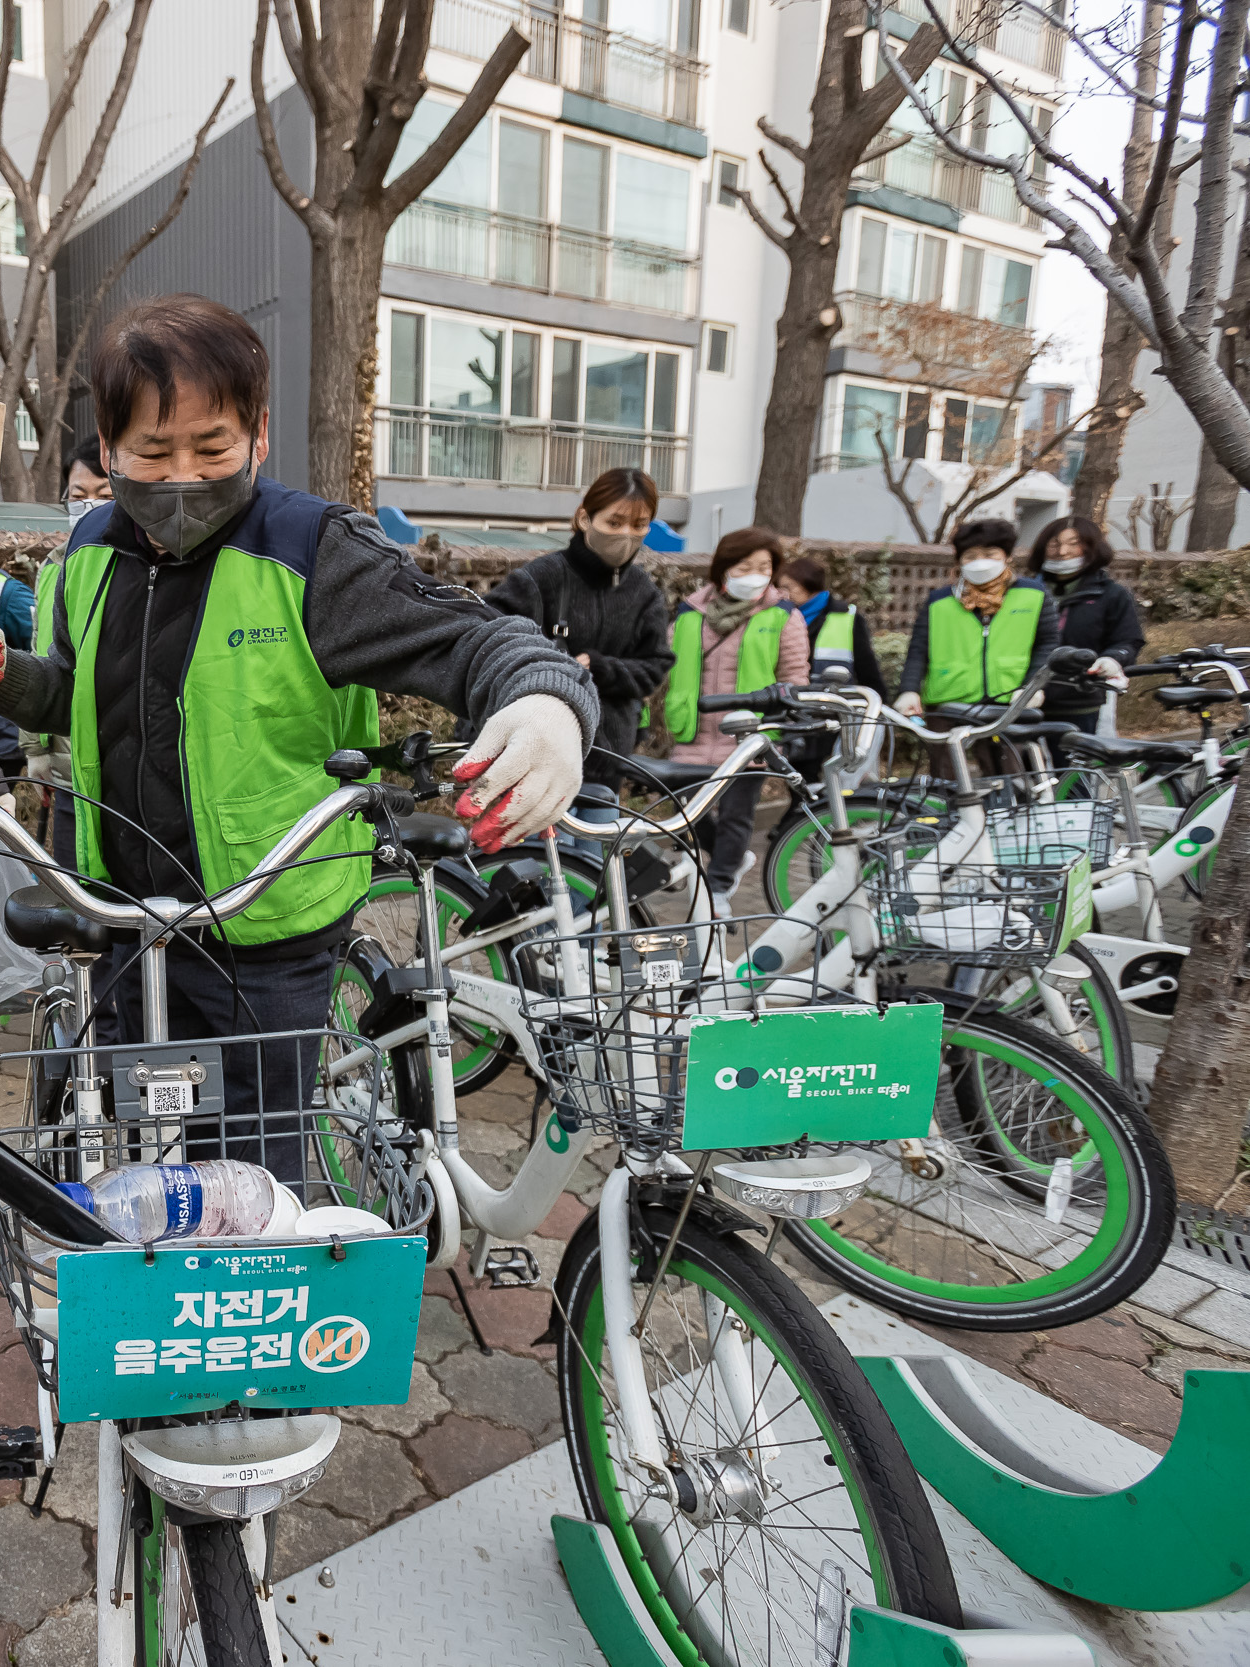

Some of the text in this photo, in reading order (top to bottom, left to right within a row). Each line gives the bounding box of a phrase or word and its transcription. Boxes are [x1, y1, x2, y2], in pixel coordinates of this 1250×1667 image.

[247, 626, 288, 639] 광진구
[247, 637, 289, 645] GWANGJIN-GU
[761, 1063, 877, 1098] 서울자전거
[805, 1082, 911, 1099] SEOUL BIKE 따릉이
[214, 1254, 286, 1276] 서울자전거
[173, 1285, 310, 1328] 자전거
[113, 1326, 362, 1376] 음주운전 NO
[178, 1391, 219, 1400] 서울특별시
[239, 1468, 259, 1481] LED
